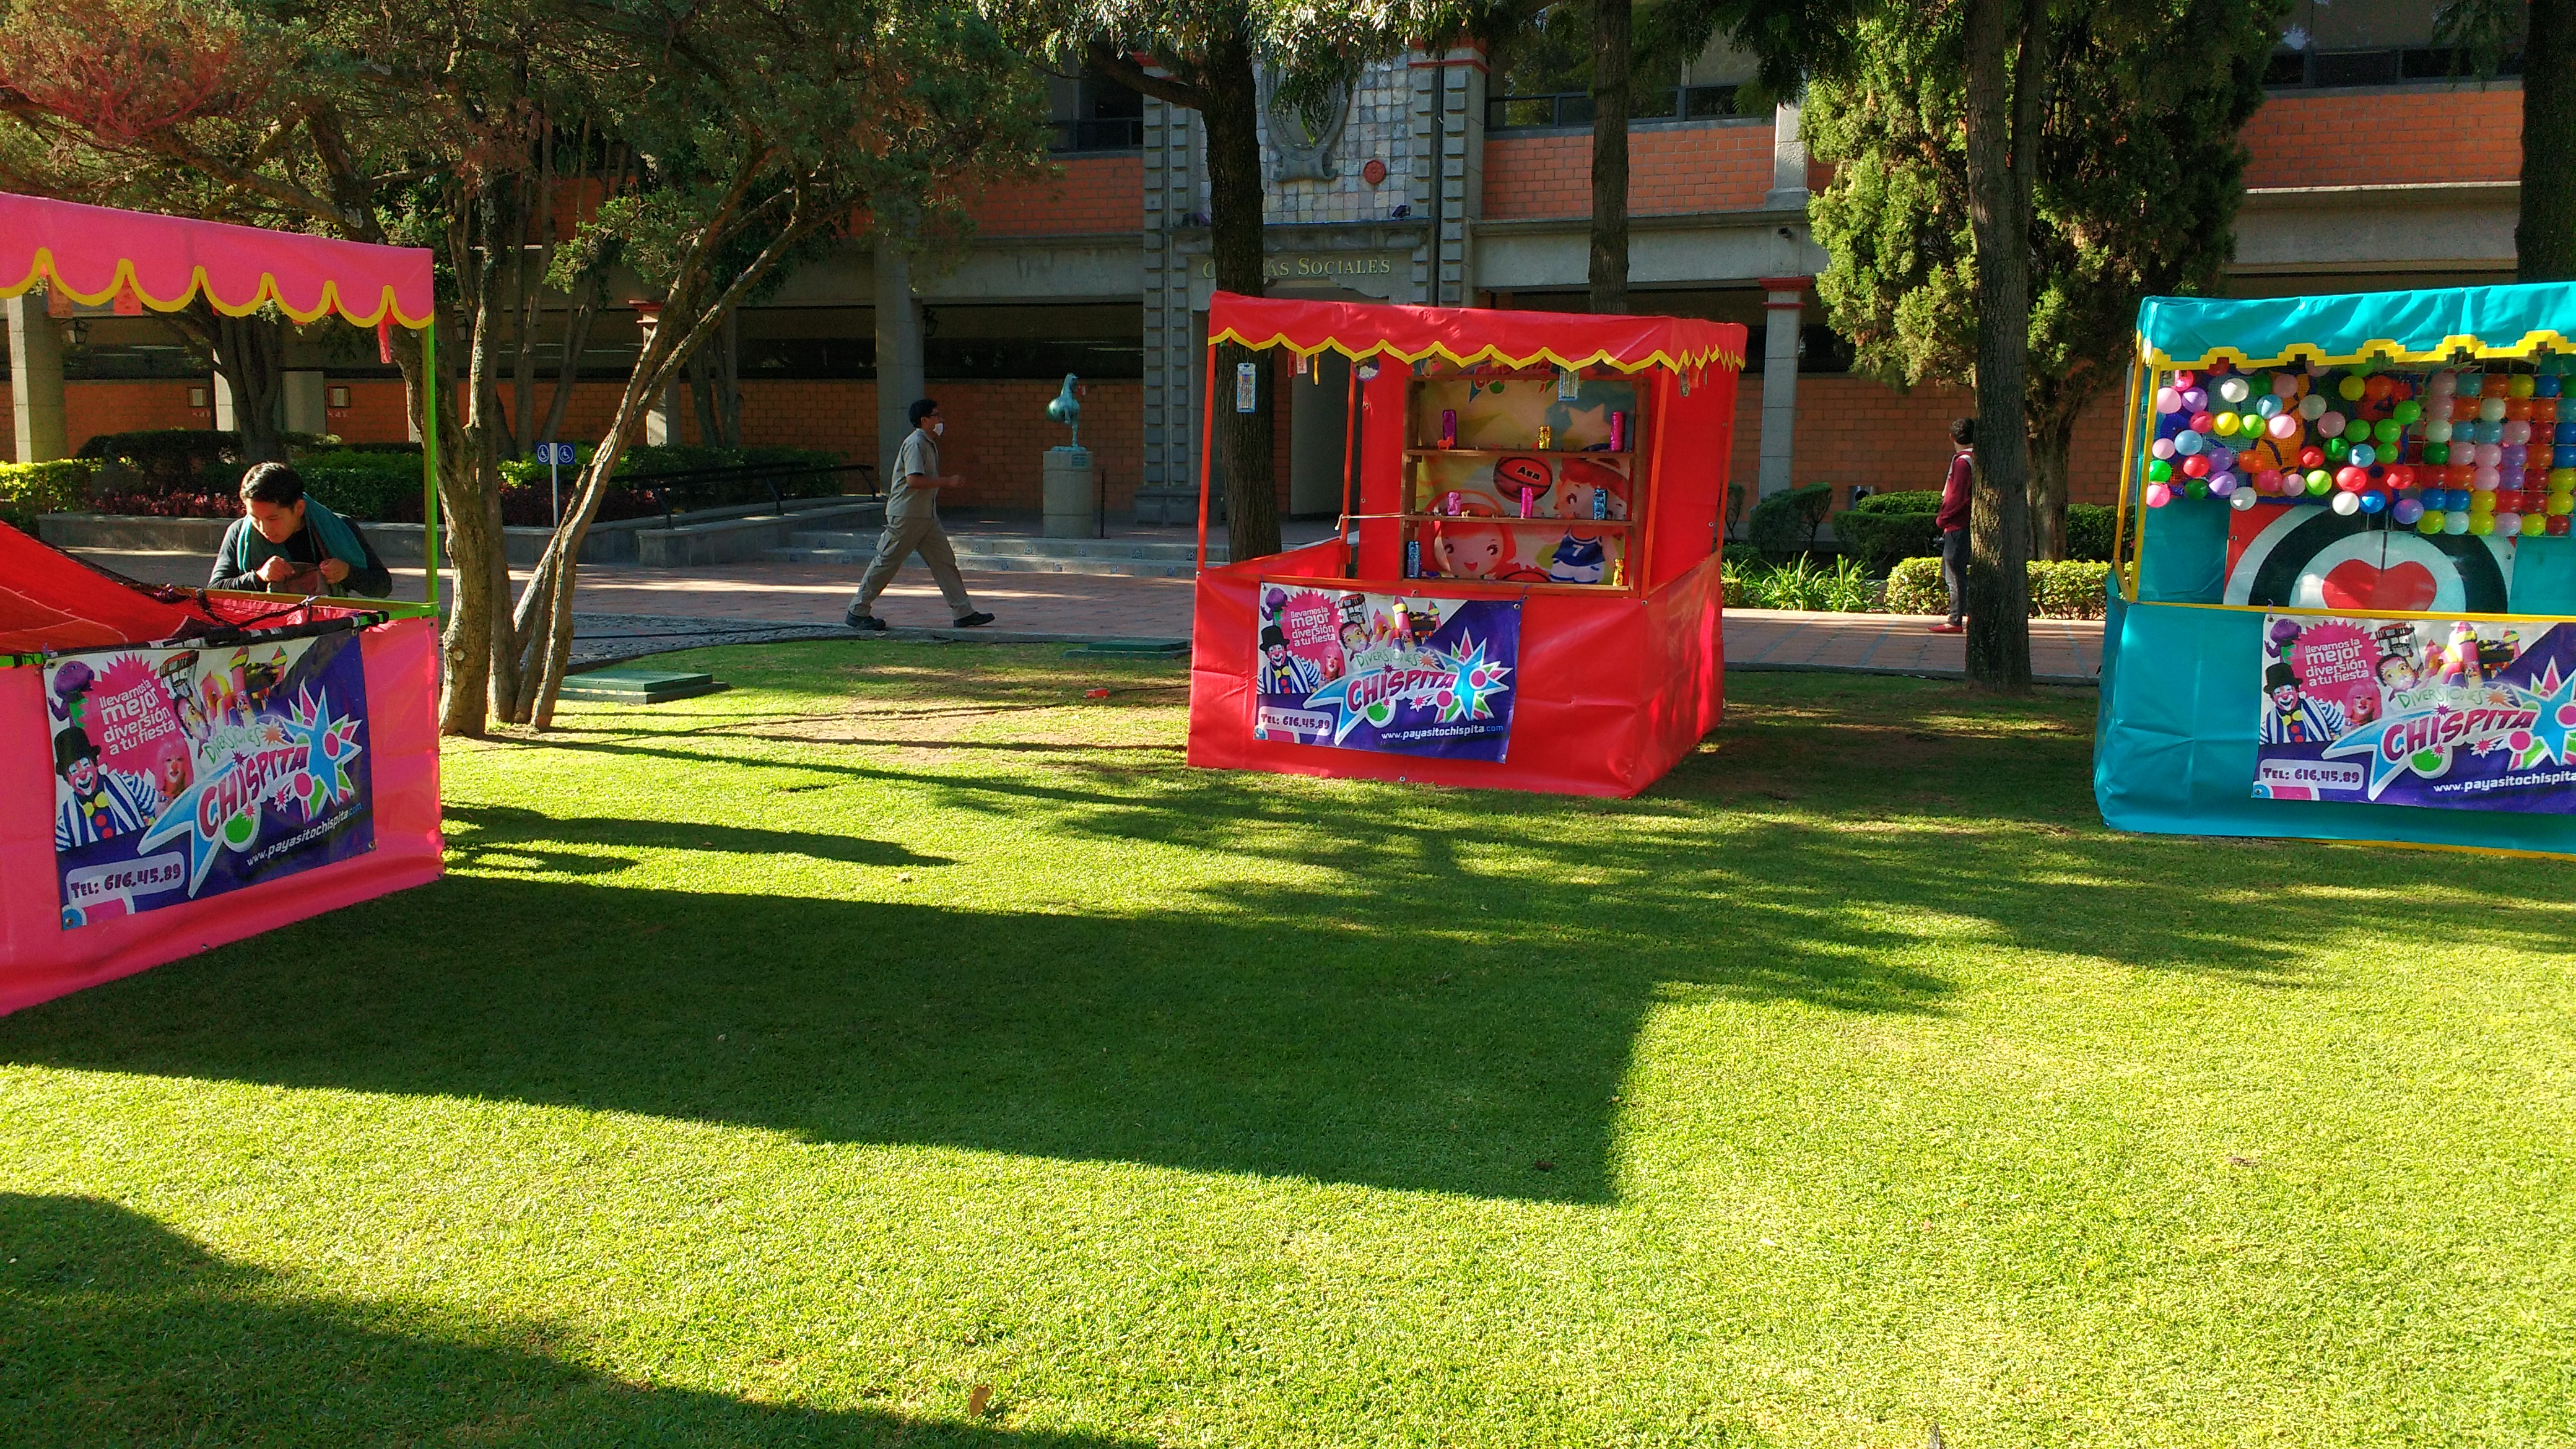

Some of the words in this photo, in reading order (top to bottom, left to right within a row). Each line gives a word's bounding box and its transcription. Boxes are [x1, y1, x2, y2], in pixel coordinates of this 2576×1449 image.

[1298, 257, 1391, 275] SOCIALES
[1572, 544, 1585, 557] 7
[1290, 607, 1321, 618] llevamos
[1291, 612, 1330, 629] mejor
[1292, 624, 1334, 638] diversión
[1300, 637, 1311, 645] tu
[1312, 633, 1336, 643] fiesta
[2305, 641, 2350, 653] llevamos
[2350, 637, 2360, 646] la
[2305, 645, 2363, 665] mejor
[2305, 659, 2367, 677] diversión
[2308, 678, 2317, 687] a
[2318, 675, 2332, 684] tu
[2333, 669, 2369, 683] fiesta
[99, 683, 146, 708] llevamos
[142, 679, 152, 689] la
[1347, 669, 1457, 711] CHISPITA
[101, 687, 159, 725] mejor
[103, 707, 171, 742] diversión
[1282, 716, 1329, 729] 616.45.89
[109, 744, 120, 755] a
[120, 736, 137, 751] tu
[138, 719, 176, 744] fiesta
[1381, 724, 1503, 740] www.payasitochispita.com
[2383, 709, 2537, 761] CHISPITA
[2294, 768, 2359, 783] 616.45.89
[199, 746, 309, 838] CHISPITA
[246, 803, 362, 866] www.payasitochispita.com
[104, 863, 181, 890] 616.45.89
